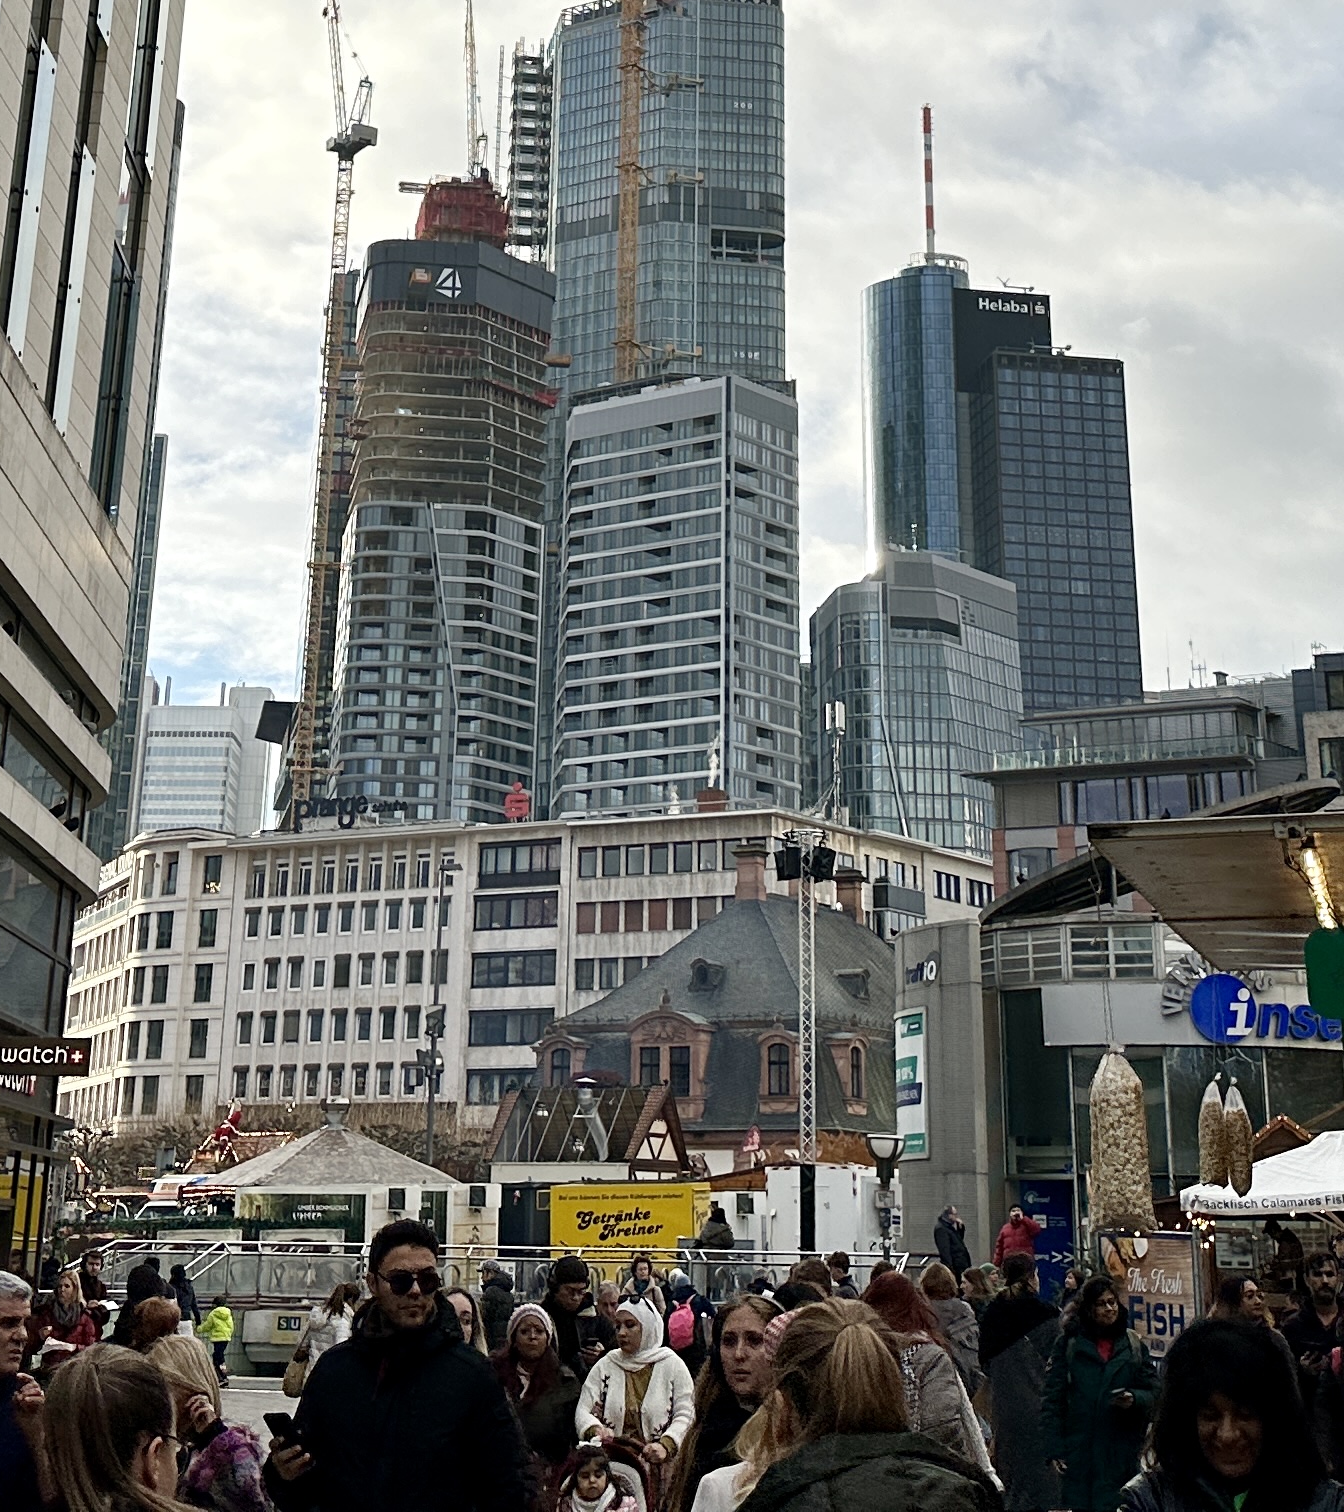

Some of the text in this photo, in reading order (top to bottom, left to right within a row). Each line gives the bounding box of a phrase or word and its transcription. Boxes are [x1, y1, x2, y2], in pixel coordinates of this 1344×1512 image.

[978, 297, 1029, 314] Helaba
[294, 795, 368, 833] prange
[1226, 988, 1343, 1042] inse
[1202, 1198, 1257, 1210] Backfisch
[1261, 1196, 1322, 1209] Calamares
[575, 1206, 651, 1230] Getränke
[598, 1223, 664, 1241] Kreiner
[1127, 1267, 1184, 1295] The Fresh
[1127, 1295, 1185, 1337] FISH
